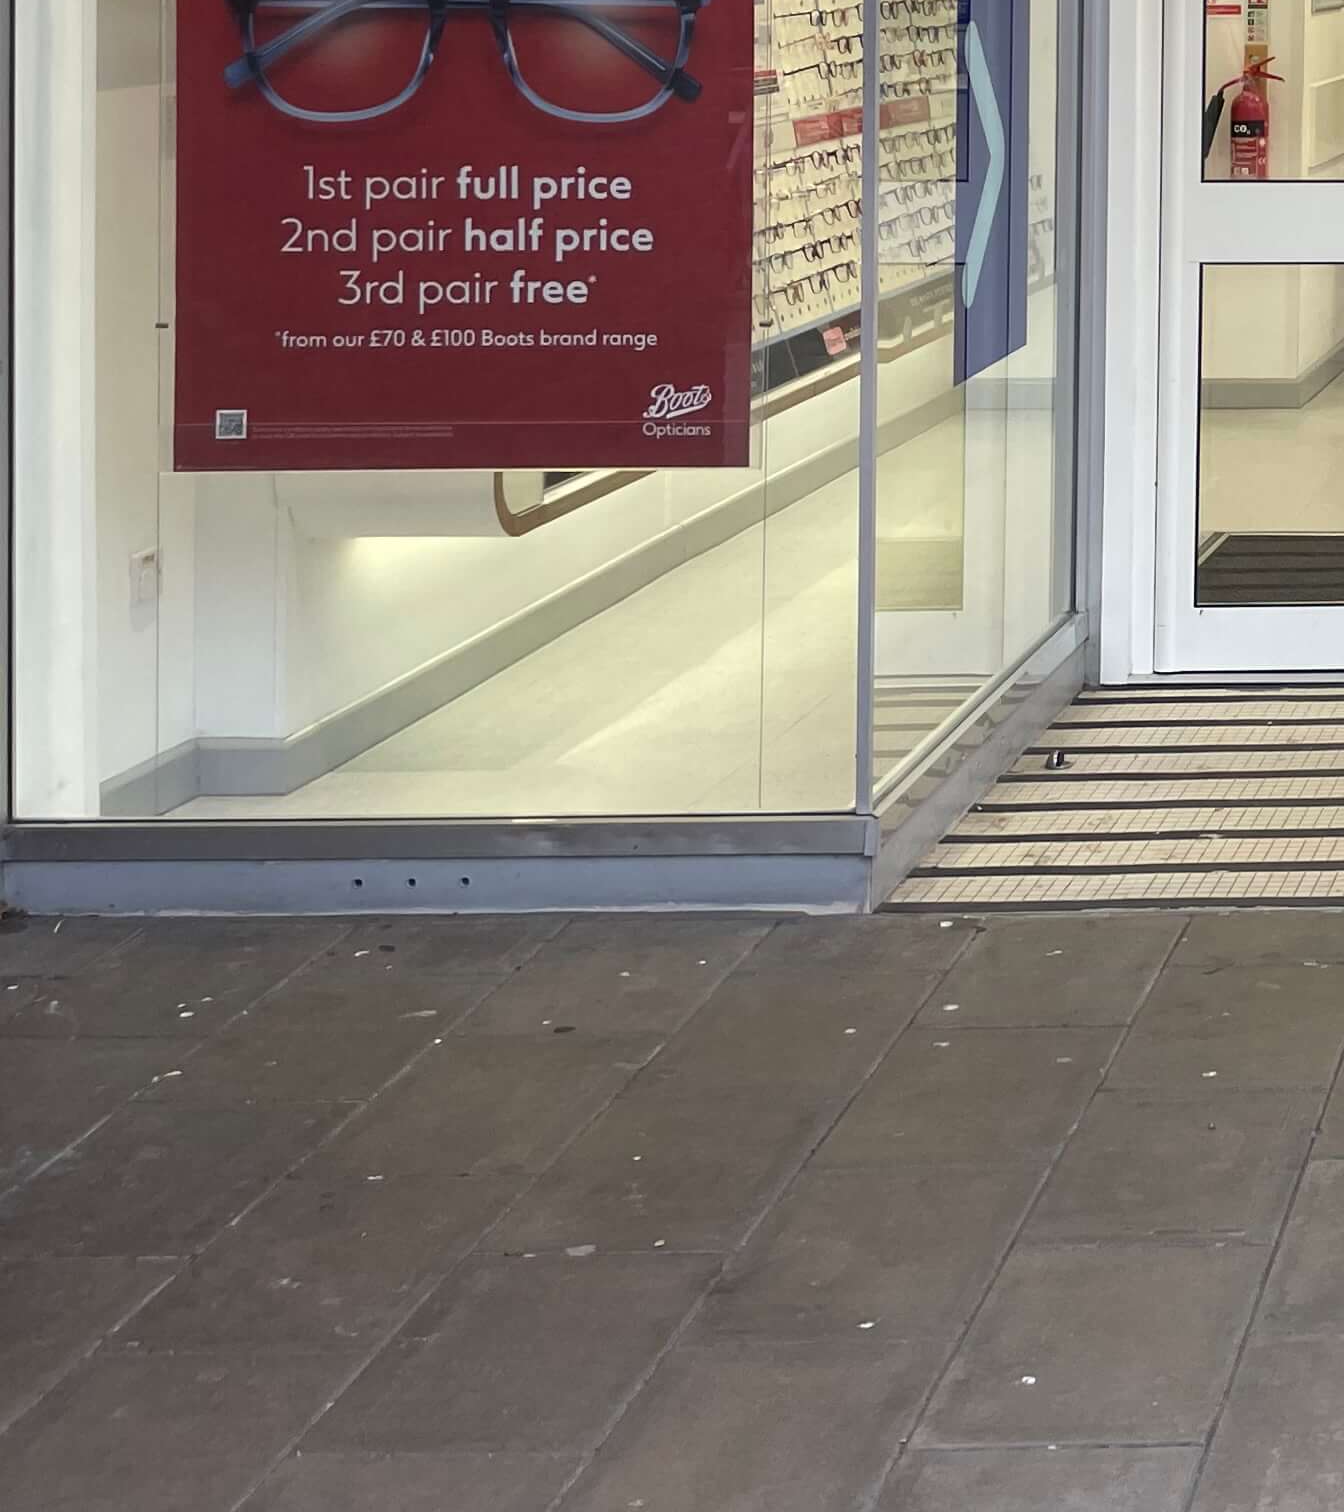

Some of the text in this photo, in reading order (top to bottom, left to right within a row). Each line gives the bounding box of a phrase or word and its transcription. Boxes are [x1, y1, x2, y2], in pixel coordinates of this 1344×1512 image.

[303, 165, 632, 210] 1st pair full price
[281, 217, 654, 262] 2nd pair half price
[338, 270, 404, 305] 3rd
[419, 272, 498, 315] pair
[333, 332, 364, 348] our
[369, 330, 402, 347] £70
[411, 330, 426, 347] &
[430, 330, 476, 347] £100
[481, 330, 535, 347] Boots
[540, 329, 597, 347] brand
[602, 332, 658, 351] range
[642, 384, 713, 419] Boots
[642, 421, 712, 439] Opticians
